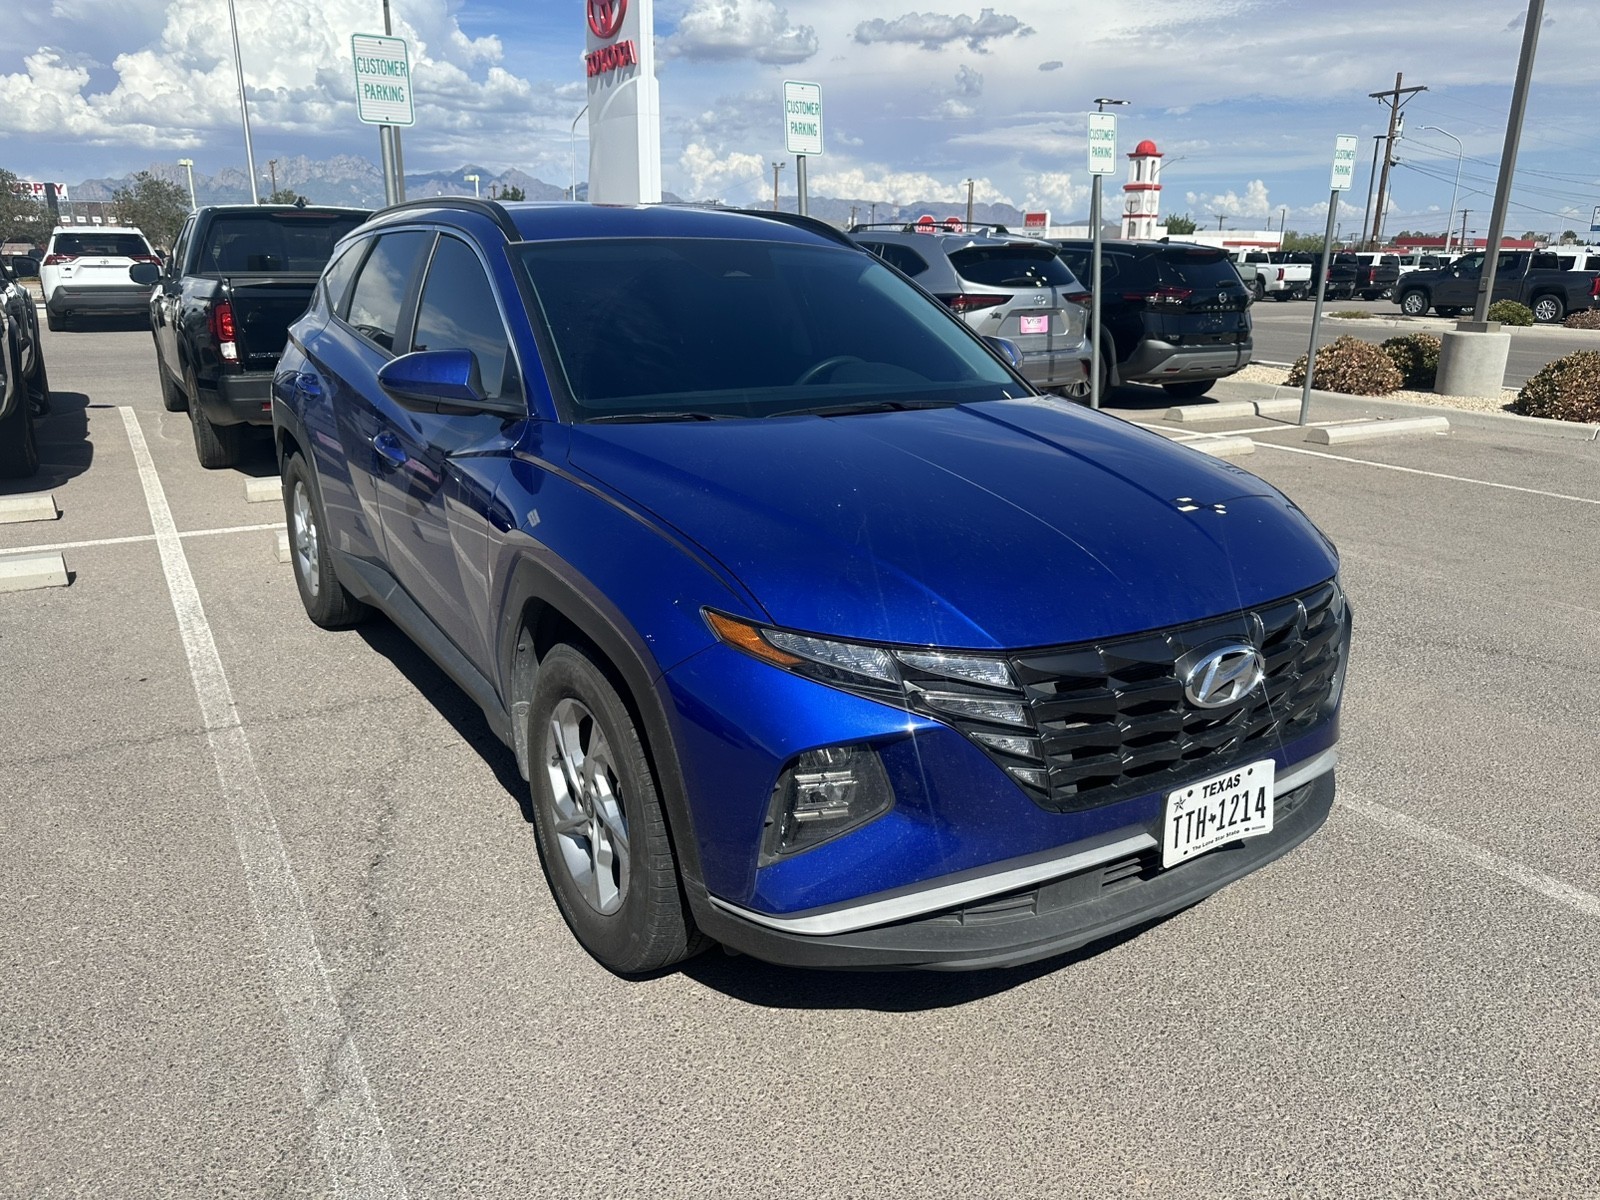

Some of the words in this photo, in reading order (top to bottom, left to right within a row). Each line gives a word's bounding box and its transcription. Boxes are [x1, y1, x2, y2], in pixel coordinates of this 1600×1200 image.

[585, 40, 637, 77] TOYOTA
[357, 57, 406, 77] CUSTOMER
[364, 83, 404, 102] PARKING
[786, 100, 820, 116] CUSTOMER
[790, 121, 817, 136] PARKING
[1089, 128, 1115, 141] CUSTOMER
[1092, 146, 1112, 158] PARKING
[1334, 149, 1355, 160] CUSTOMER
[1334, 165, 1350, 176] PARKING
[1202, 774, 1241, 799] TEXAS
[1192, 844, 1201, 852] The
[1202, 839, 1214, 847] Lone
[1215, 834, 1225, 842] Star
[1226, 830, 1240, 838] State
